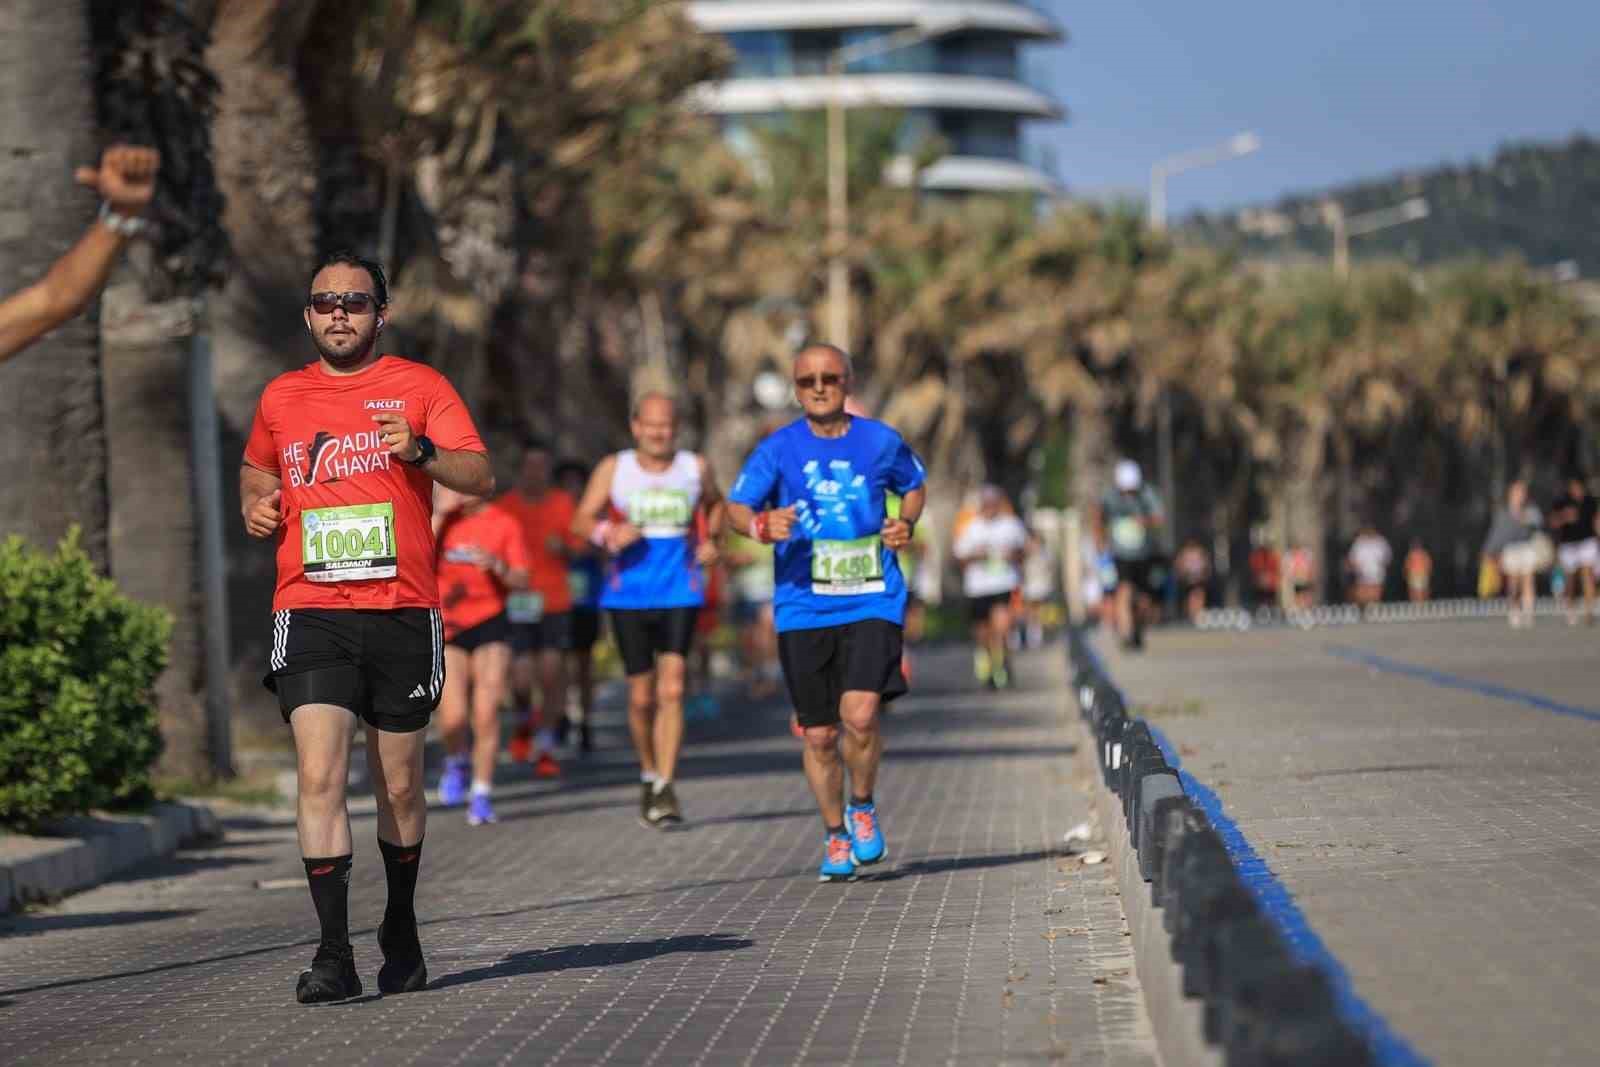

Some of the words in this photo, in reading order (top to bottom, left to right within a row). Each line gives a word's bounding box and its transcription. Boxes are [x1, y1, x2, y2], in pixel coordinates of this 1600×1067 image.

[366, 400, 403, 409] AKUT
[335, 451, 391, 477] HAYAT
[310, 527, 384, 560] 1004
[325, 560, 372, 570] SALOMON
